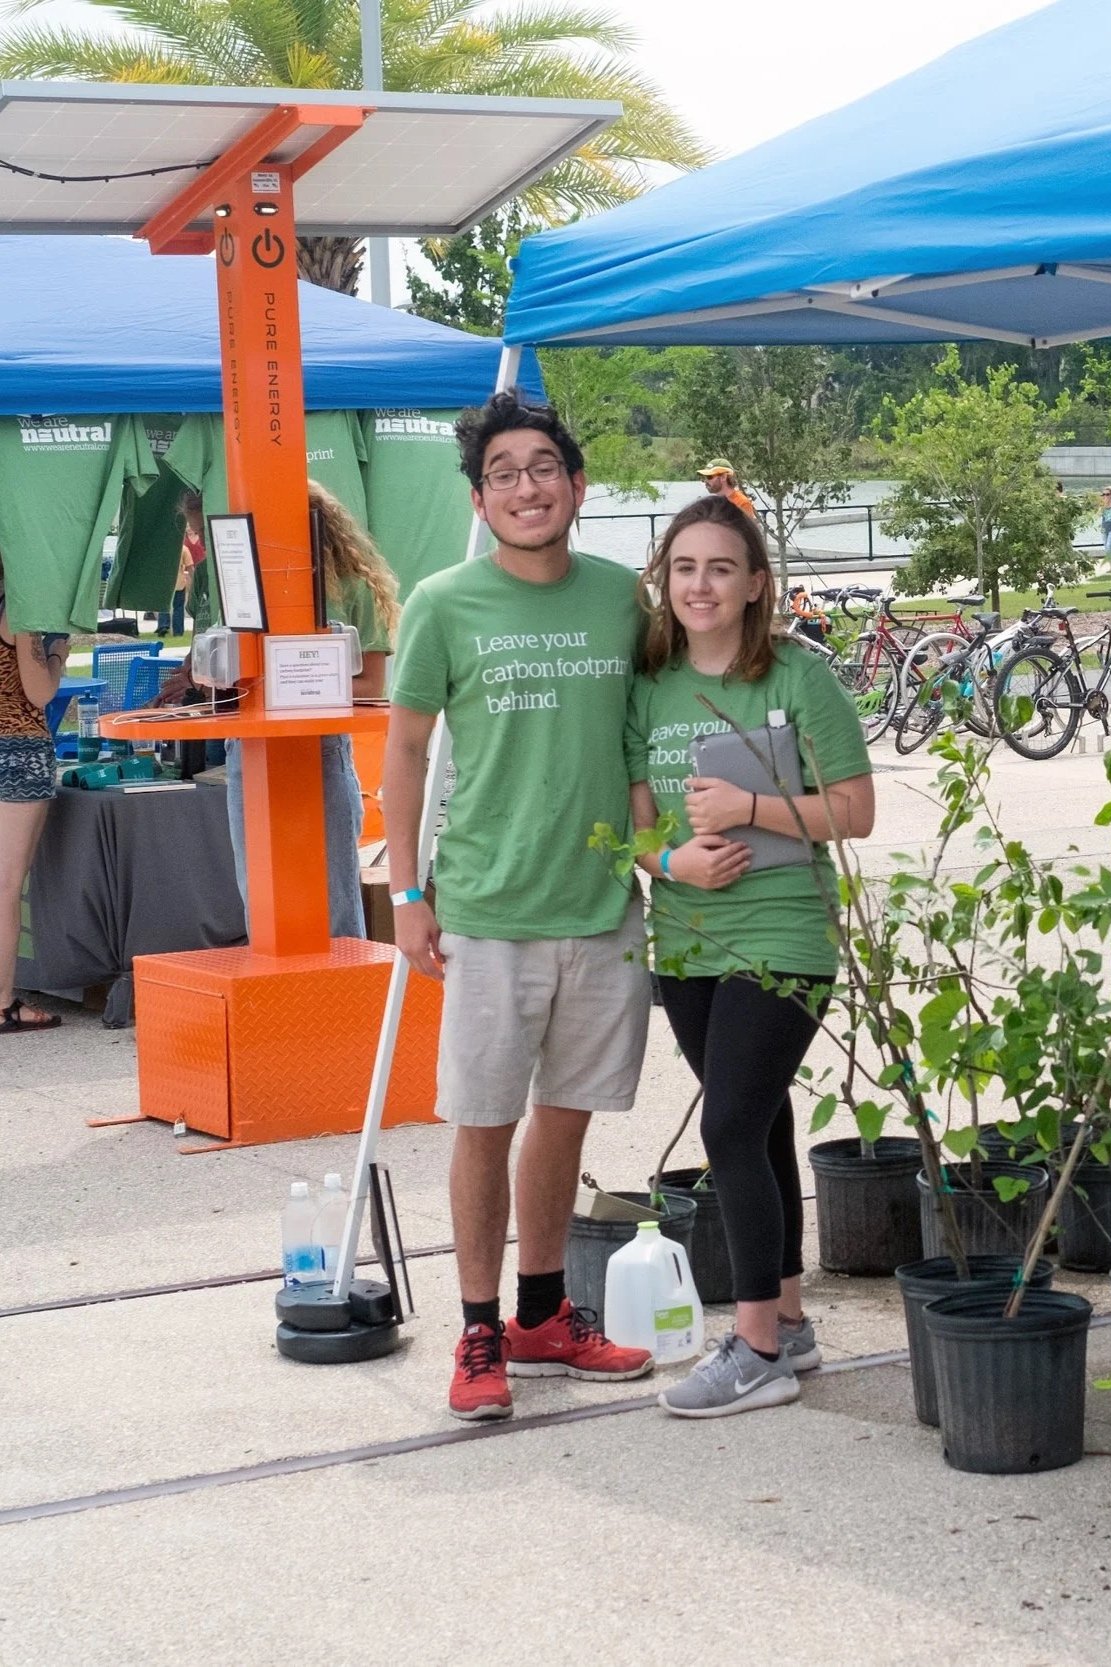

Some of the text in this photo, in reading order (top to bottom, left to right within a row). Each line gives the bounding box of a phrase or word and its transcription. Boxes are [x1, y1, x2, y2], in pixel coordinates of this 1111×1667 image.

[226, 291, 241, 444] PURE ENERGY
[264, 292, 282, 447] PURE ENERGY
[17, 416, 68, 428] we are
[375, 407, 421, 418] we are
[20, 422, 112, 443] neutral
[299, 650, 320, 659] HEY!
[474, 631, 589, 656] Leave your
[482, 659, 556, 685] carbon
[647, 723, 690, 745] eave
